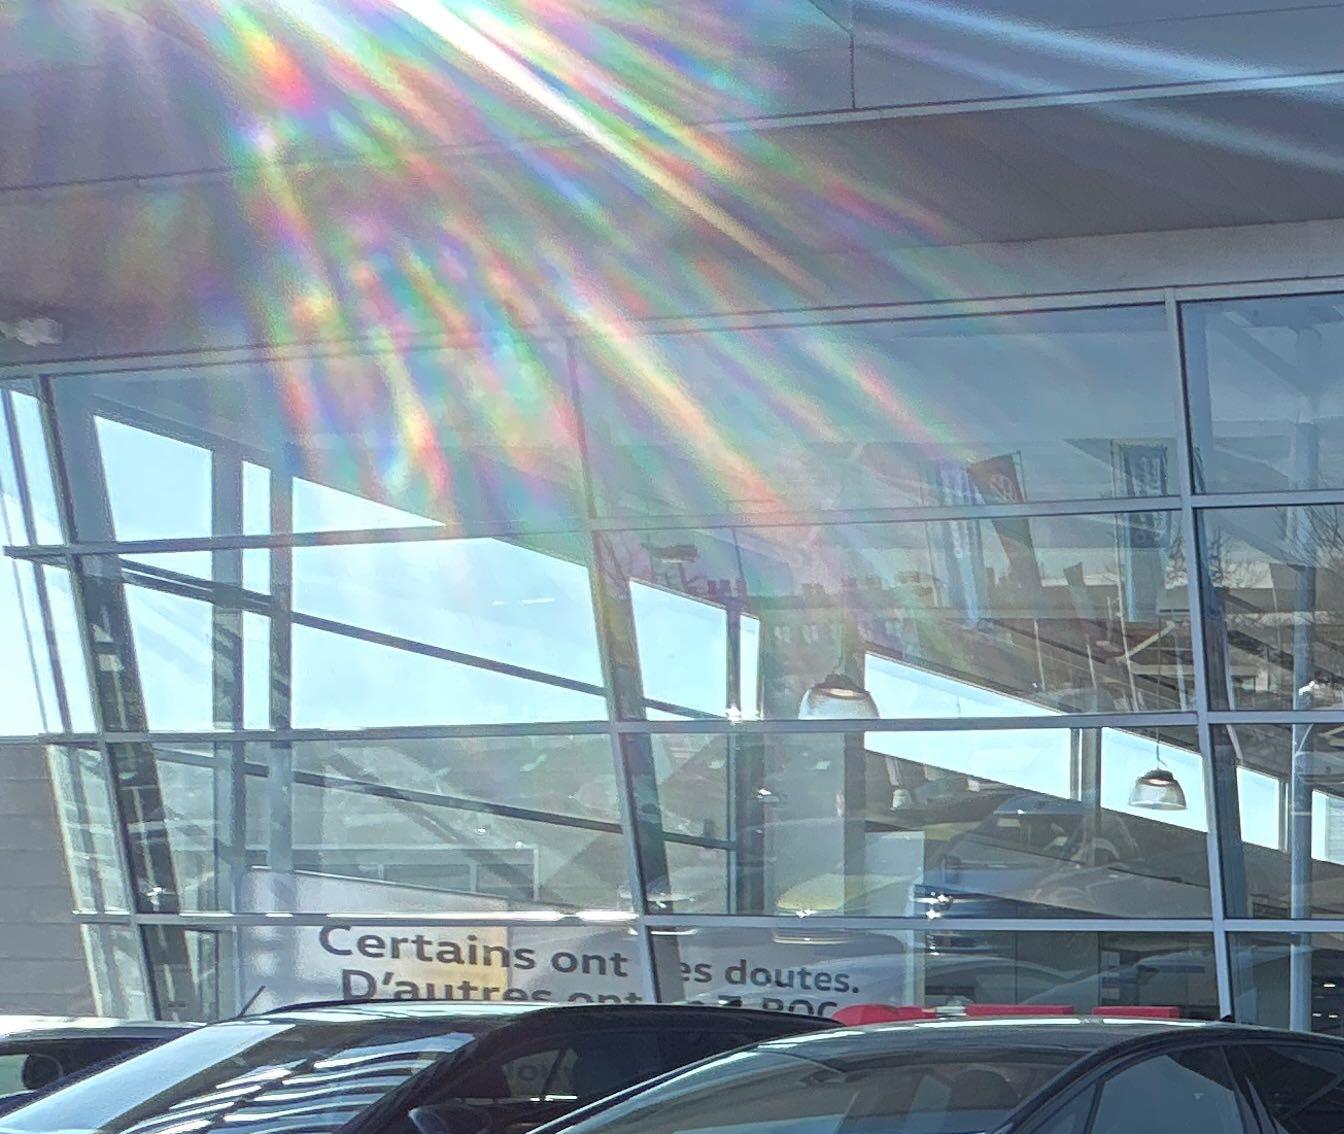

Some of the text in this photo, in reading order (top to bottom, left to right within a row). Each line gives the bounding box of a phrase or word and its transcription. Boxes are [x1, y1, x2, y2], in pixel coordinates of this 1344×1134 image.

[319, 925, 536, 969] Certains
[552, 951, 628, 977] ont
[725, 959, 860, 993] doutes.
